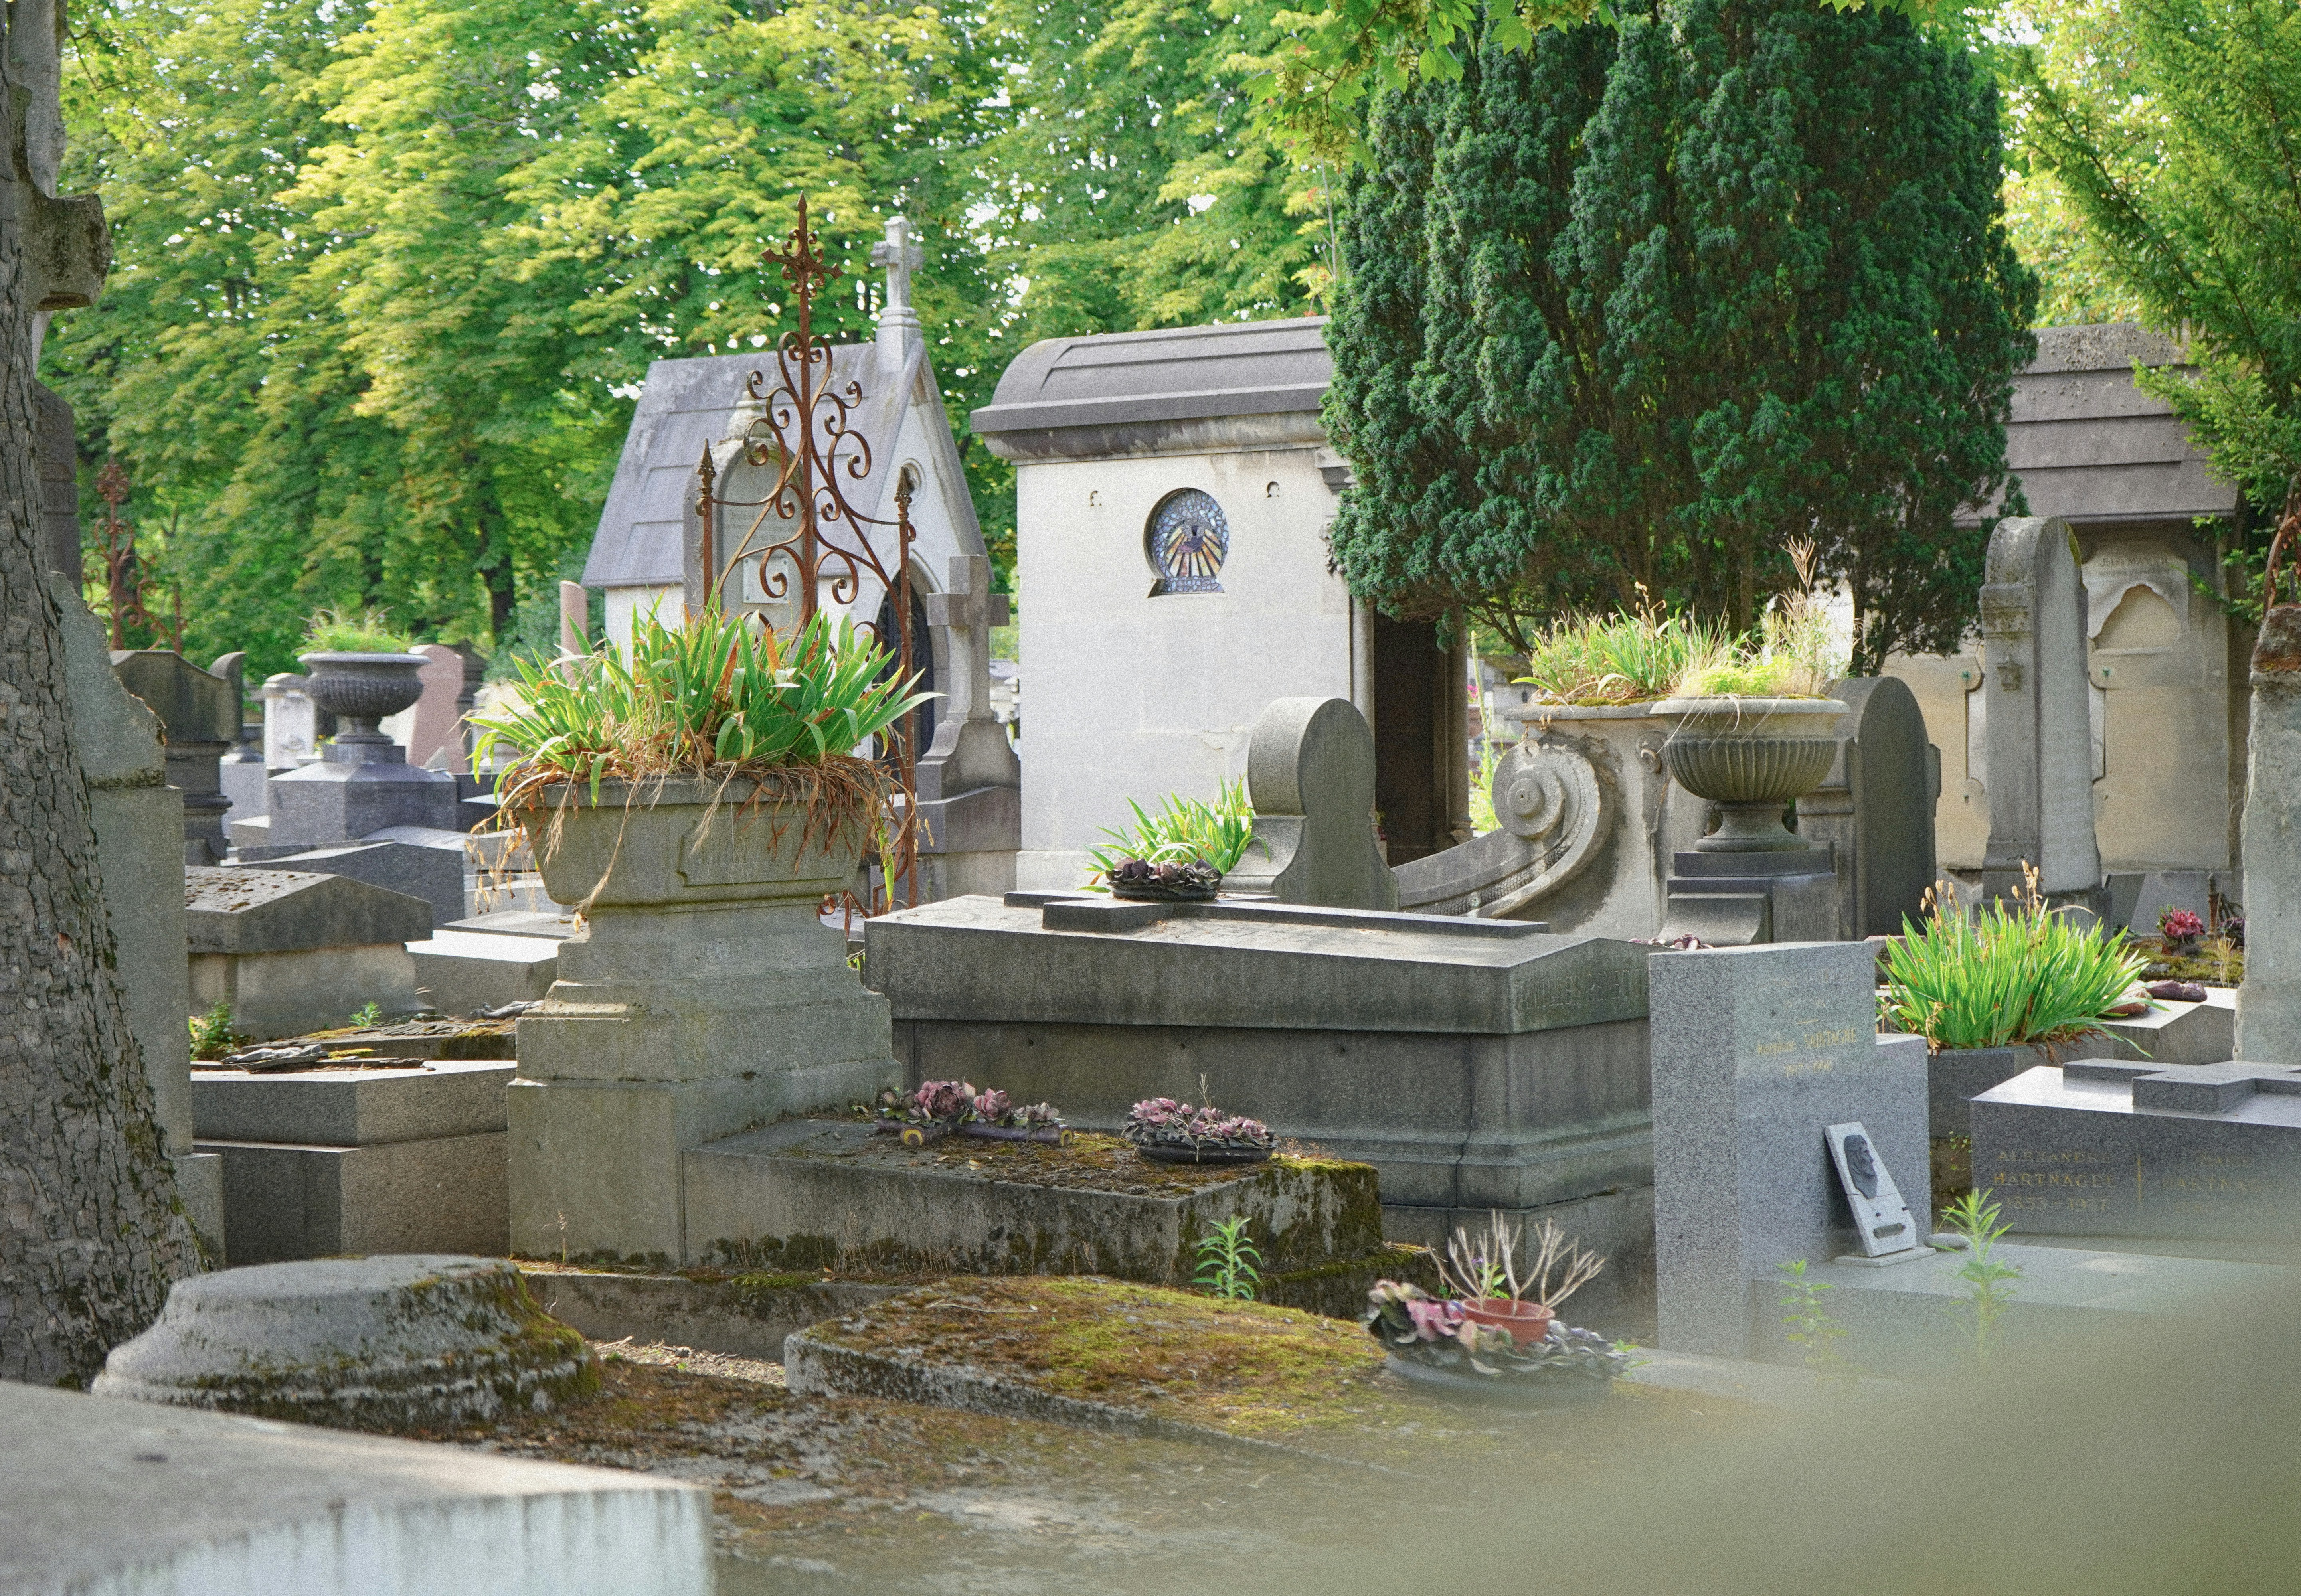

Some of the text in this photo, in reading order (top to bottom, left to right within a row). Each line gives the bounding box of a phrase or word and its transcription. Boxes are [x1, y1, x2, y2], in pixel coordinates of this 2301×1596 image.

[1996, 1150, 2111, 1163] ALEXANDRE
[1993, 1172, 2117, 1187] HARTNAGEL
[2162, 1177, 2288, 1192] HARTNAG
